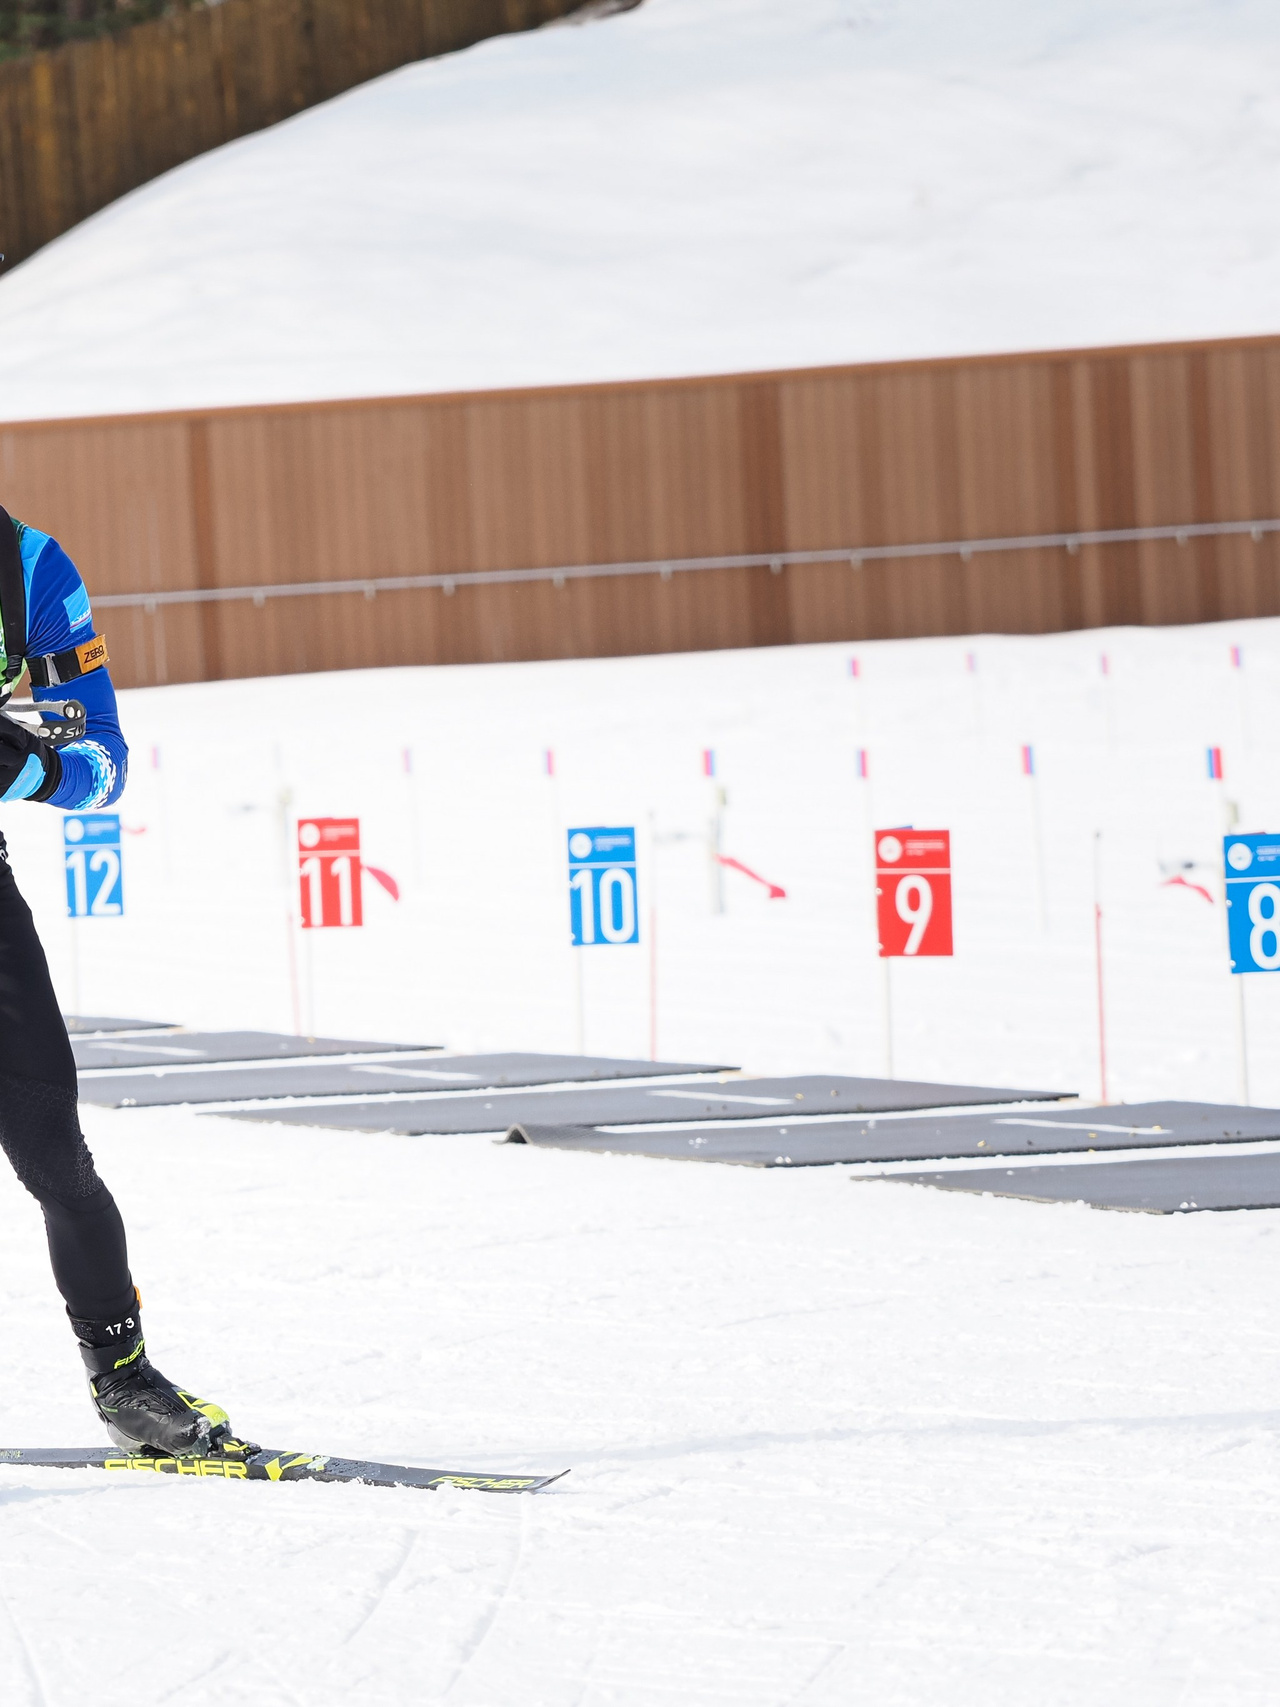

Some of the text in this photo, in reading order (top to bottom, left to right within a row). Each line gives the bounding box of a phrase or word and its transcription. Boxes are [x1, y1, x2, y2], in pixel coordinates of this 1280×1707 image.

[83, 645, 105, 664] ZERO
[66, 850, 121, 915] 12
[302, 857, 354, 925] 11
[571, 868, 637, 943] 10
[895, 874, 933, 955] 9
[1248, 882, 1280, 970] 8
